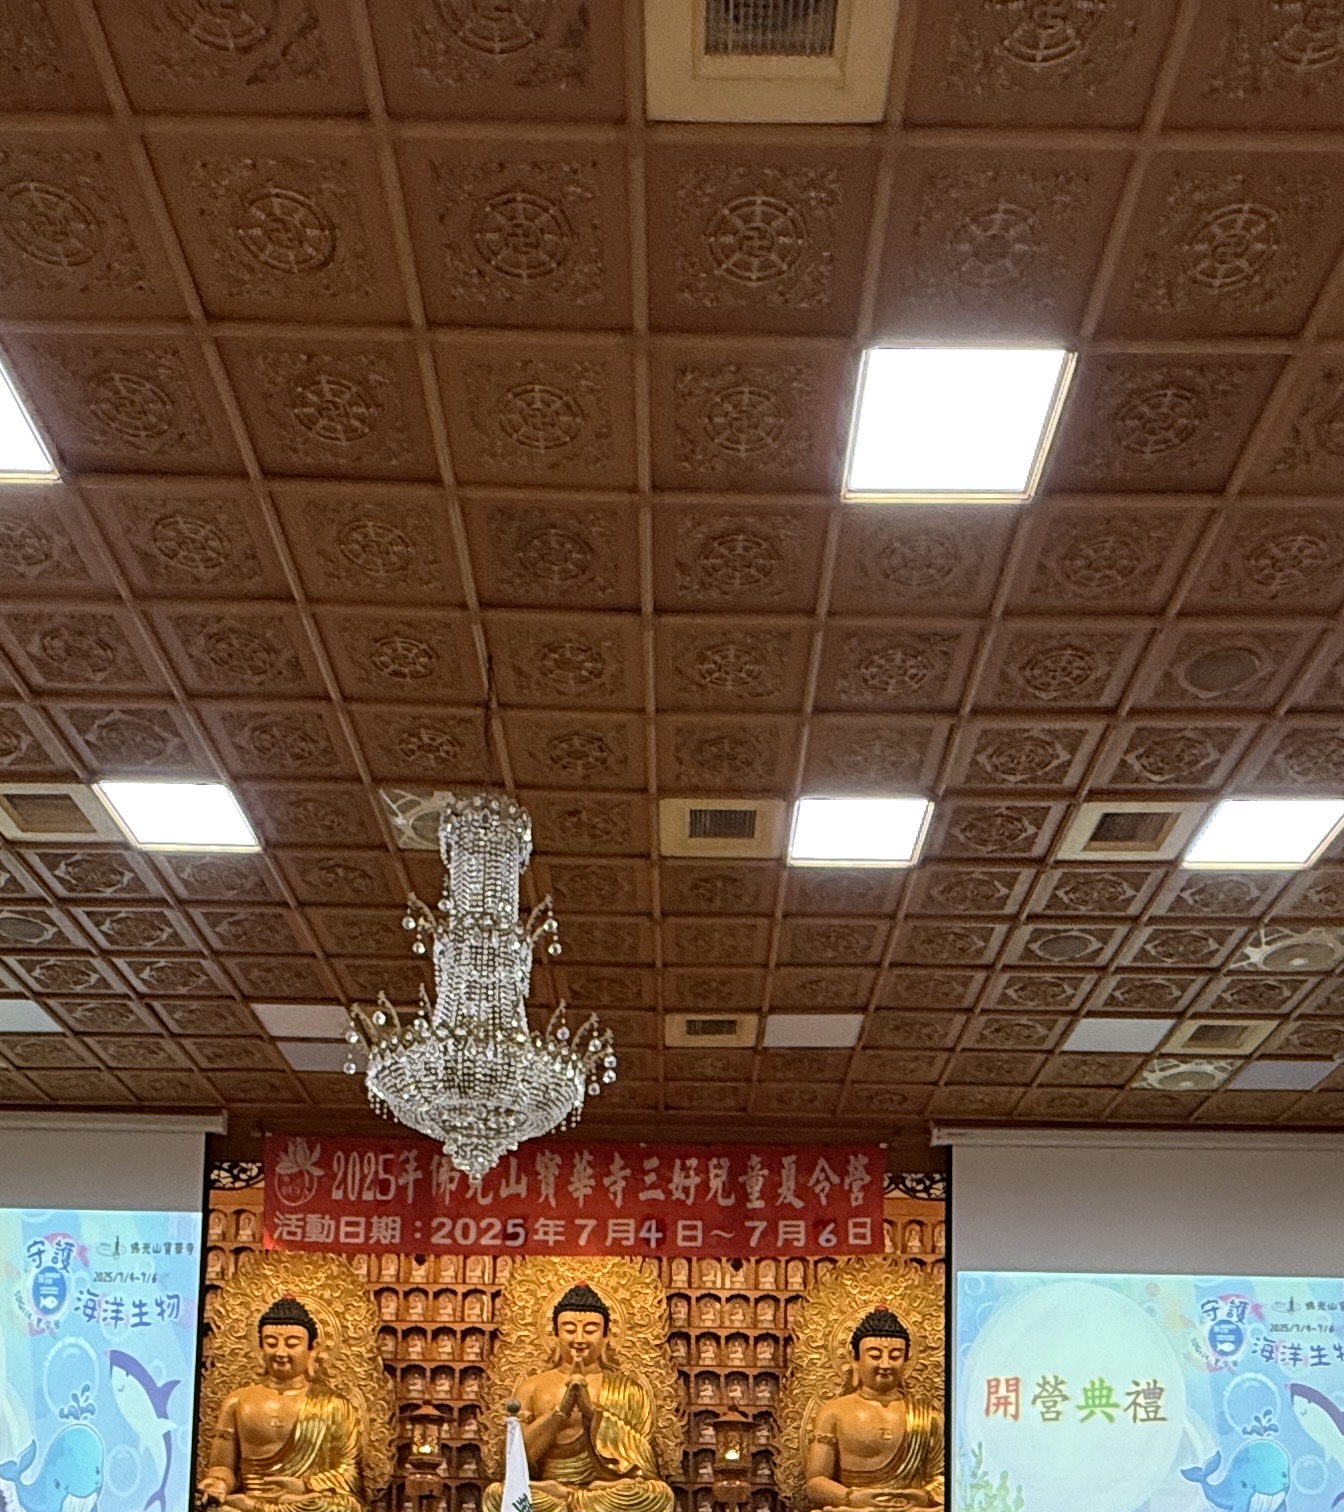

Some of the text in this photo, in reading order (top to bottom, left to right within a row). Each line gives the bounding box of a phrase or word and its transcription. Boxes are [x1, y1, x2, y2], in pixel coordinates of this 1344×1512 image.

[25, 1239, 76, 1275] 守護
[73, 1288, 182, 1330] 海洋生物
[1199, 1298, 1250, 1326] 守護
[983, 1373, 1169, 1425] 開營典禮
